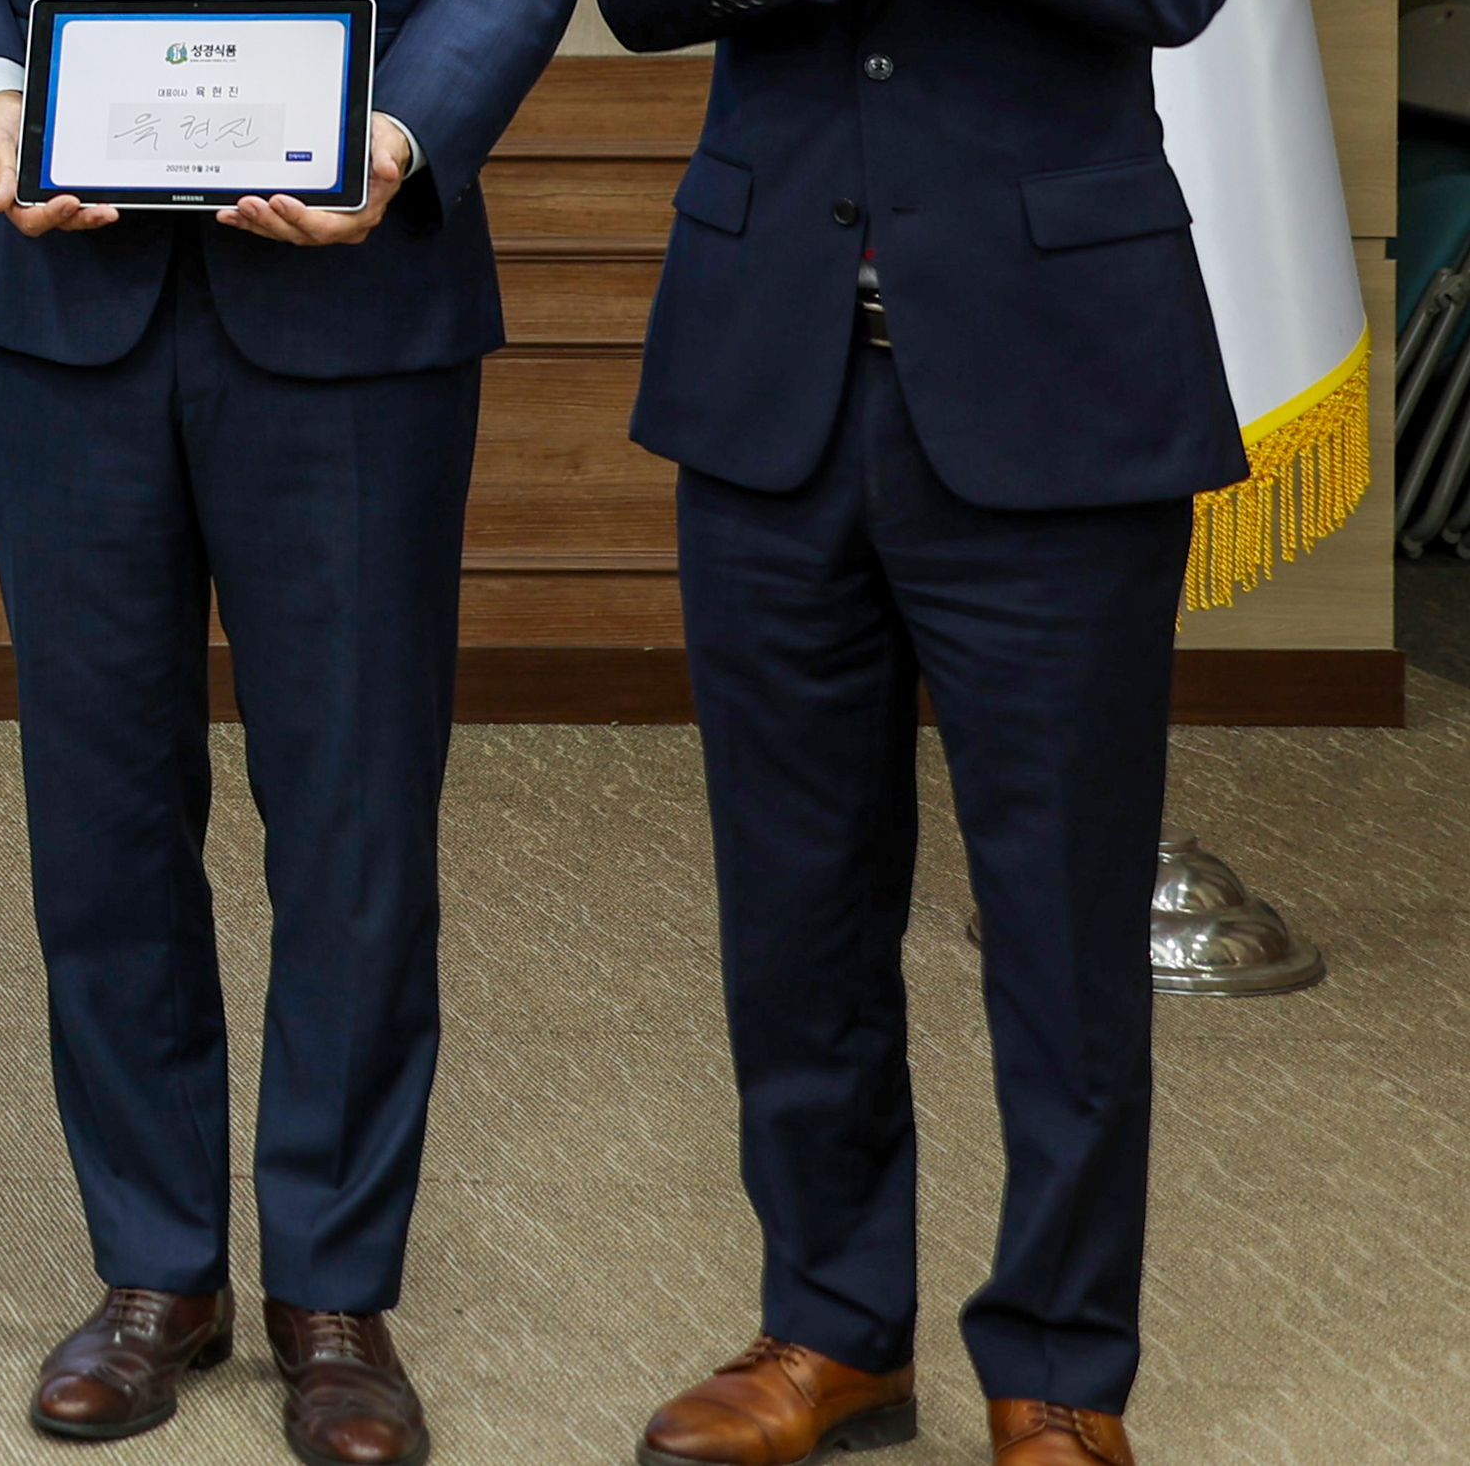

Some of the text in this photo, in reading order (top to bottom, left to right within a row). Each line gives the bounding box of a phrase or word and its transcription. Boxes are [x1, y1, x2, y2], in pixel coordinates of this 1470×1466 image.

[190, 44, 237, 58] 성경식품
[157, 88, 188, 98] 대표이사
[165, 164, 221, 174] 2025년 9월 24일
[171, 194, 205, 202] SAMSUNG
